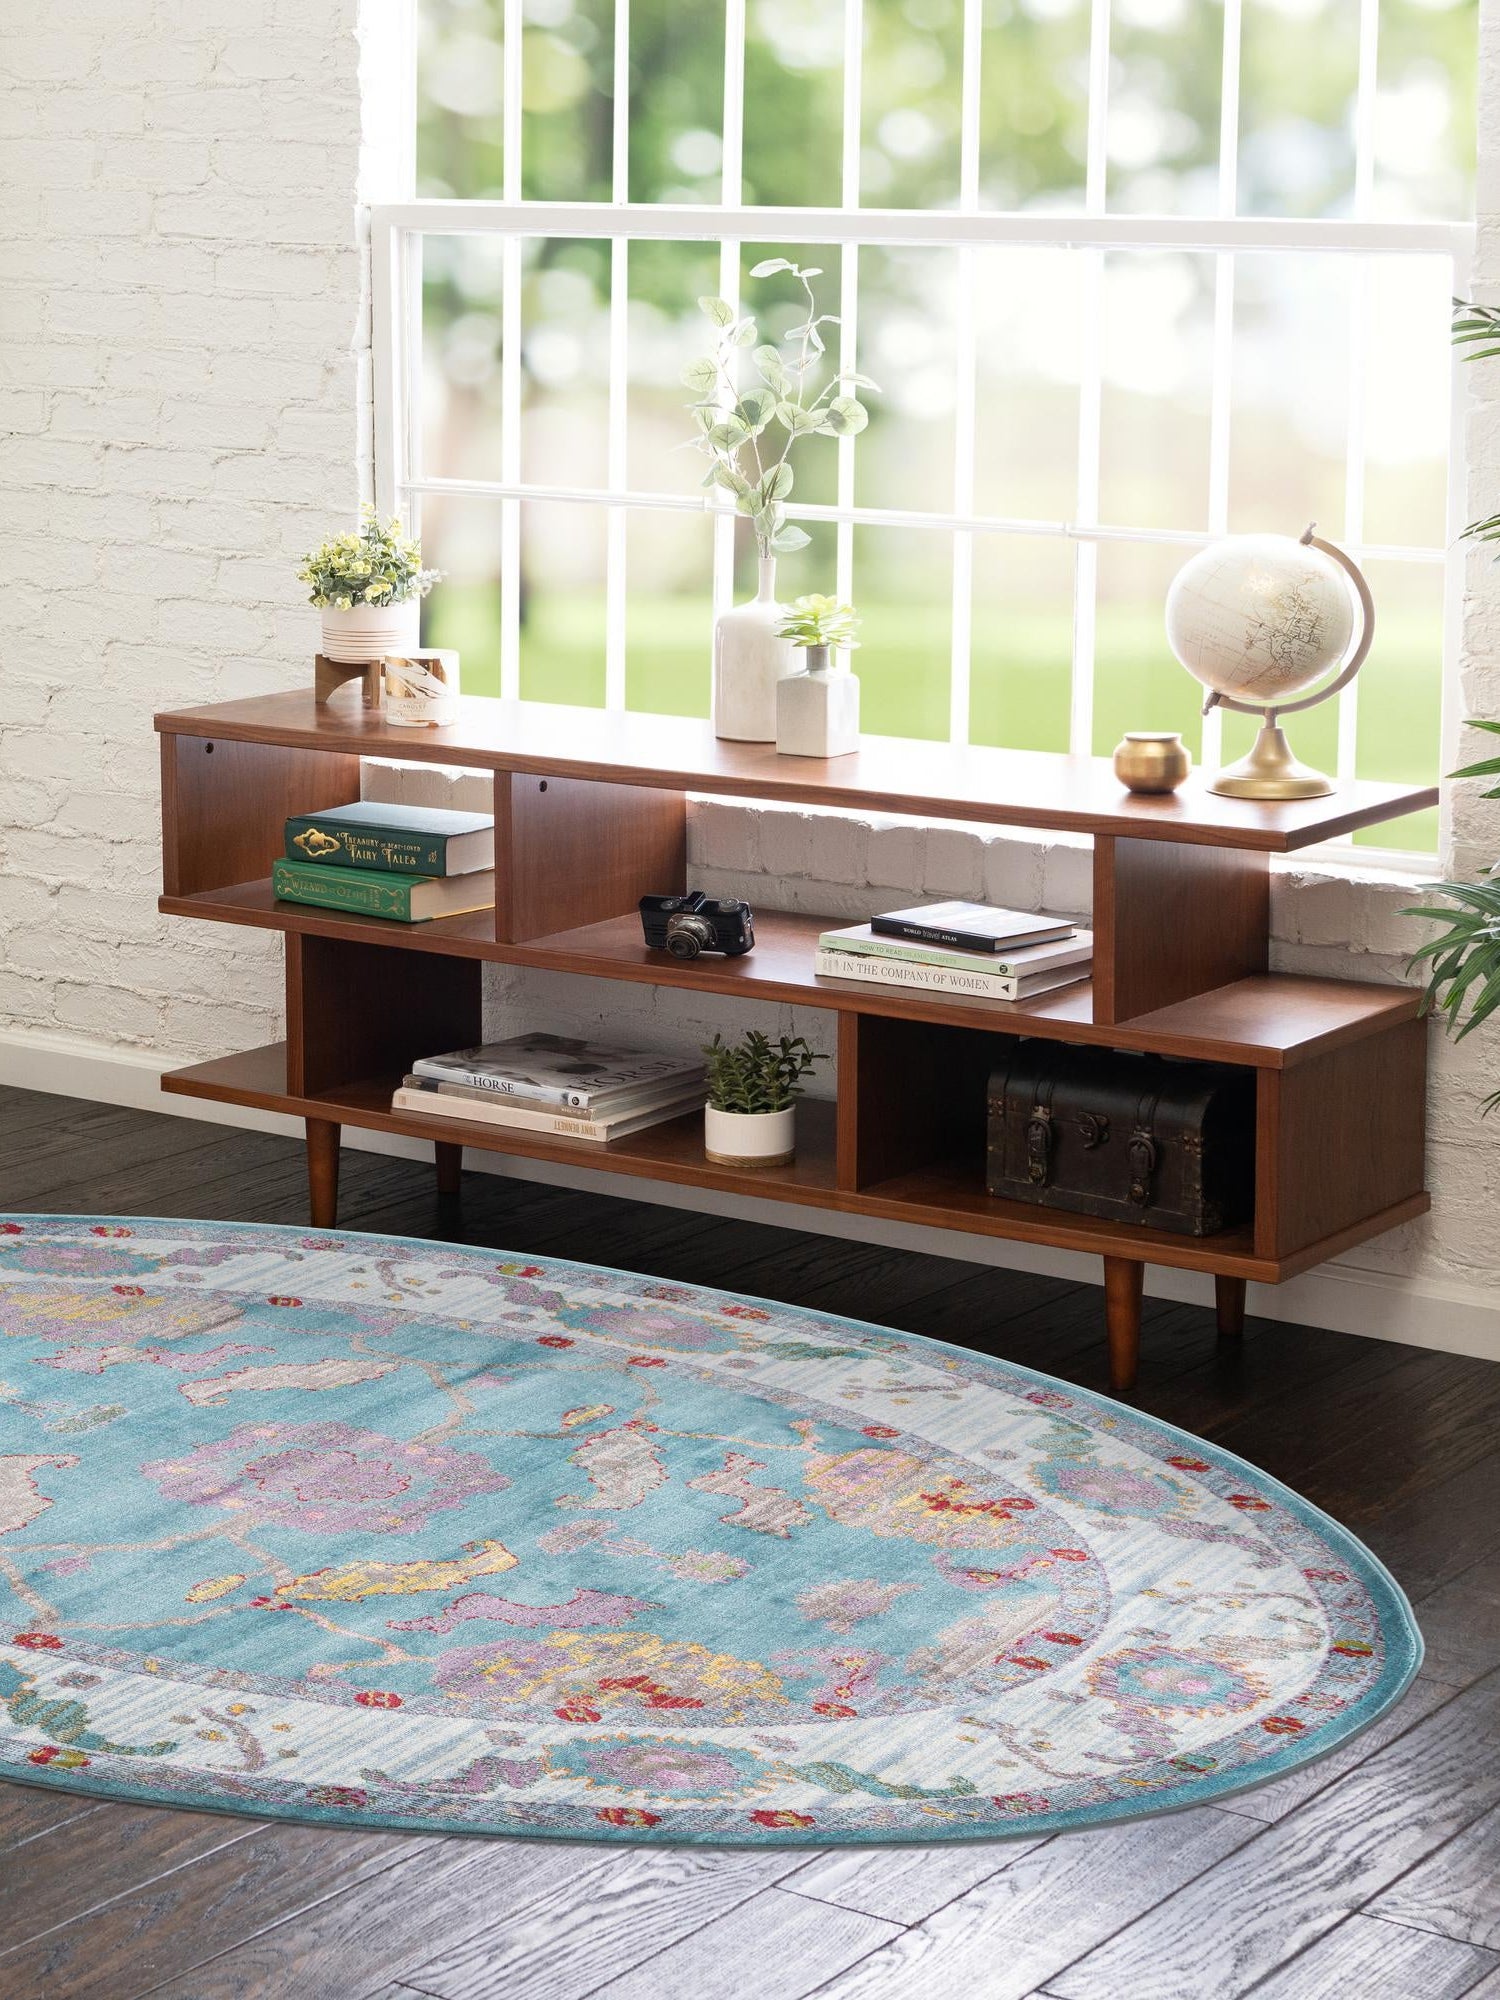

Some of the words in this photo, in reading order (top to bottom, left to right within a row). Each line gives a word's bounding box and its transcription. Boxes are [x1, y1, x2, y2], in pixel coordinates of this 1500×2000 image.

[340, 831, 379, 848] TREASURY
[345, 844, 378, 864] FAIRY
[381, 848, 417, 869] TALES
[290, 878, 328, 894] WIZARD
[903, 927, 922, 935] WORLD
[941, 934, 958, 942] ATLAS
[859, 944, 875, 952] HOW
[875, 945, 884, 953] TO
[886, 947, 903, 956] READ
[843, 961, 854, 972] IN
[856, 963, 878, 976] THE
[880, 966, 931, 982] COMPANY
[932, 973, 947, 985] OF
[949, 975, 990, 991] WOMEN
[473, 1075, 515, 1094] HORSE
[564, 1059, 688, 1092] HORSE
